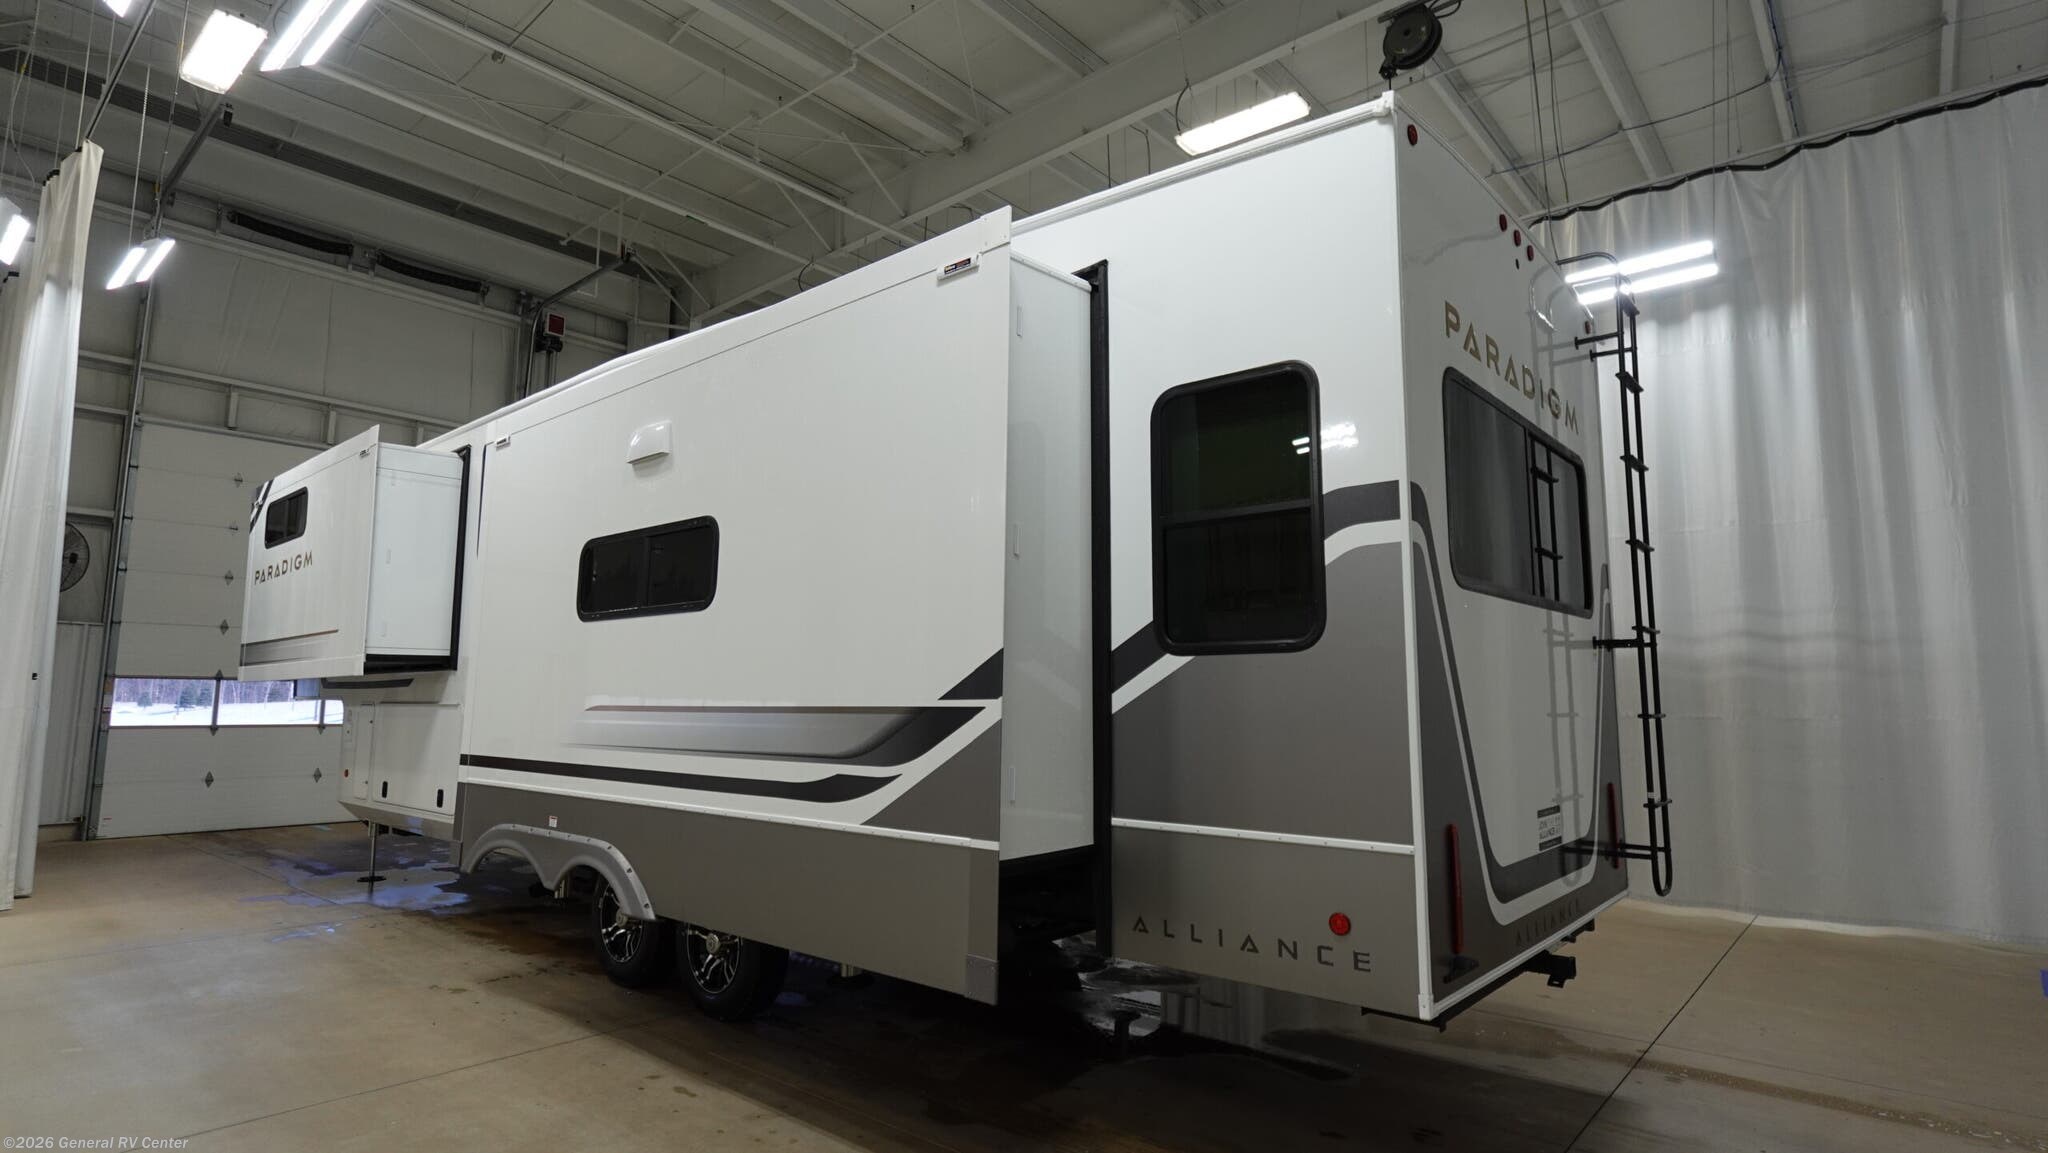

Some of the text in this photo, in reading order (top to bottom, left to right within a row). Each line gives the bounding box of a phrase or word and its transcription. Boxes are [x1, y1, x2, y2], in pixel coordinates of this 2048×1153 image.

[1444, 300, 1580, 435] PARADIGM
[254, 550, 313, 586] PARADIGM
[1132, 915, 1372, 973] ALLIANCE
